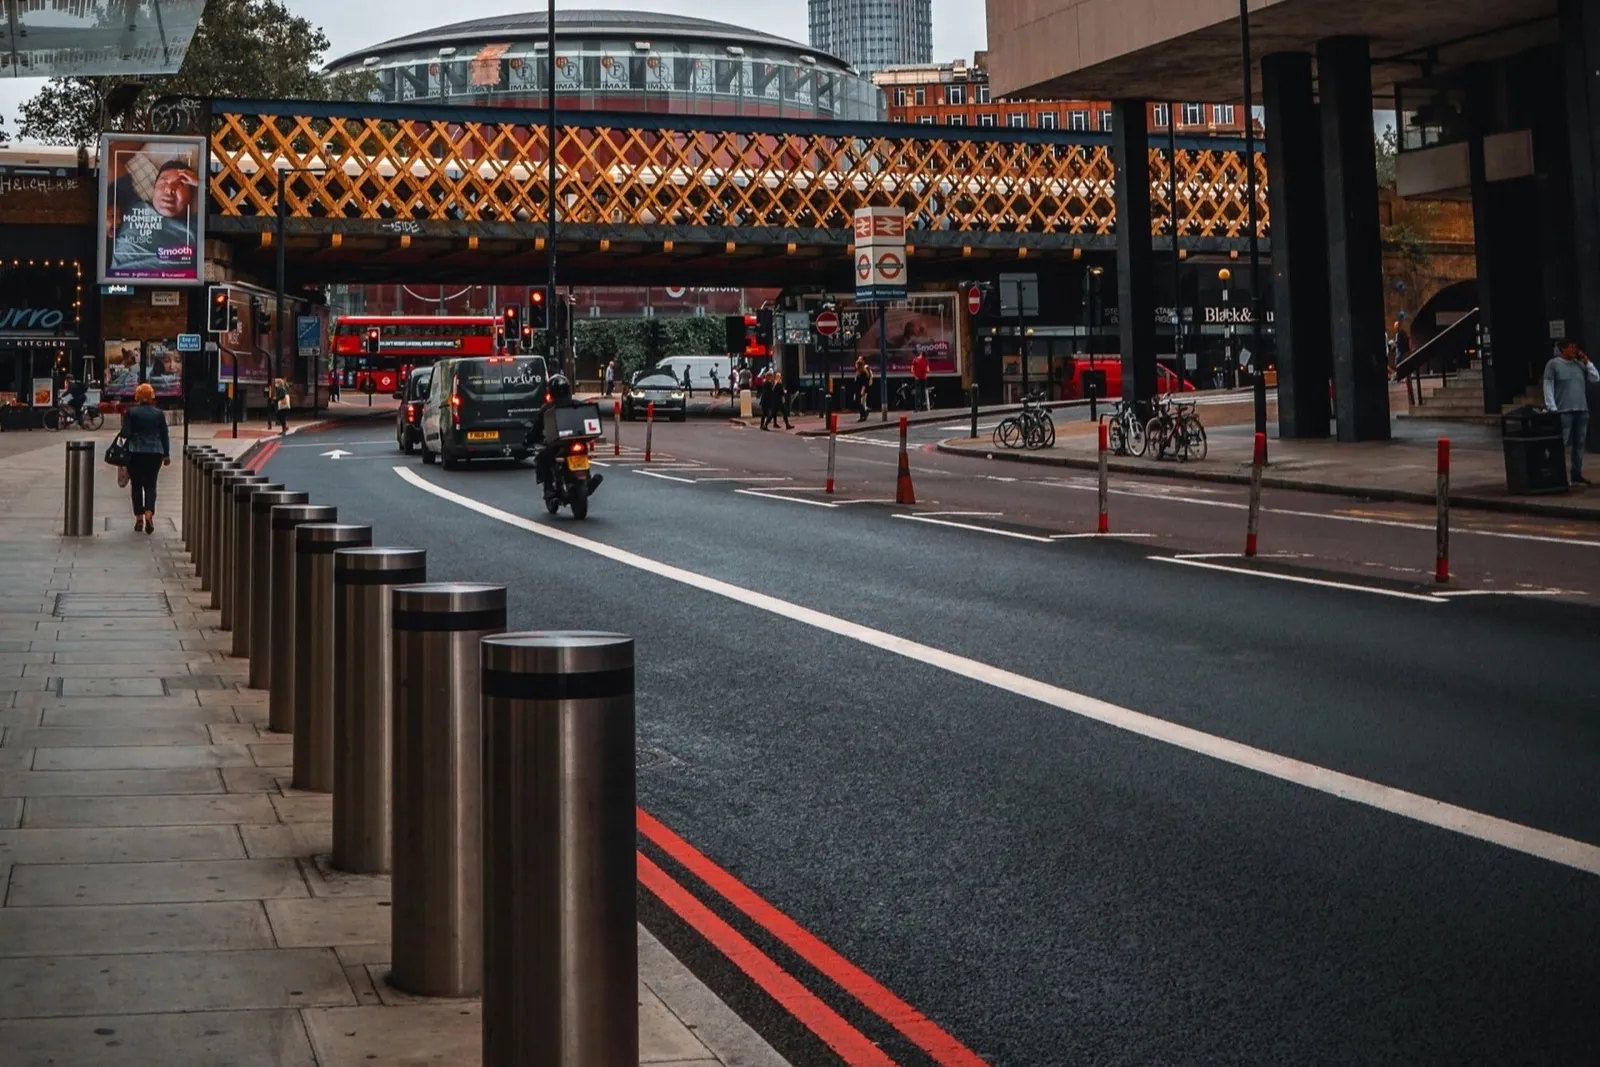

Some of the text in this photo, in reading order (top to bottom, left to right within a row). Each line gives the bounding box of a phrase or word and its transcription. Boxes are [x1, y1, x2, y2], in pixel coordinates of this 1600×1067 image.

[123, 214, 163, 222] MOMENT
[135, 222, 163, 230] WAKE
[125, 236, 153, 244] MUSIC
[157, 246, 192, 256] Smooth
[107, 285, 128, 294] global
[915, 342, 948, 352] Smooth
[588, 421, 597, 432] L
